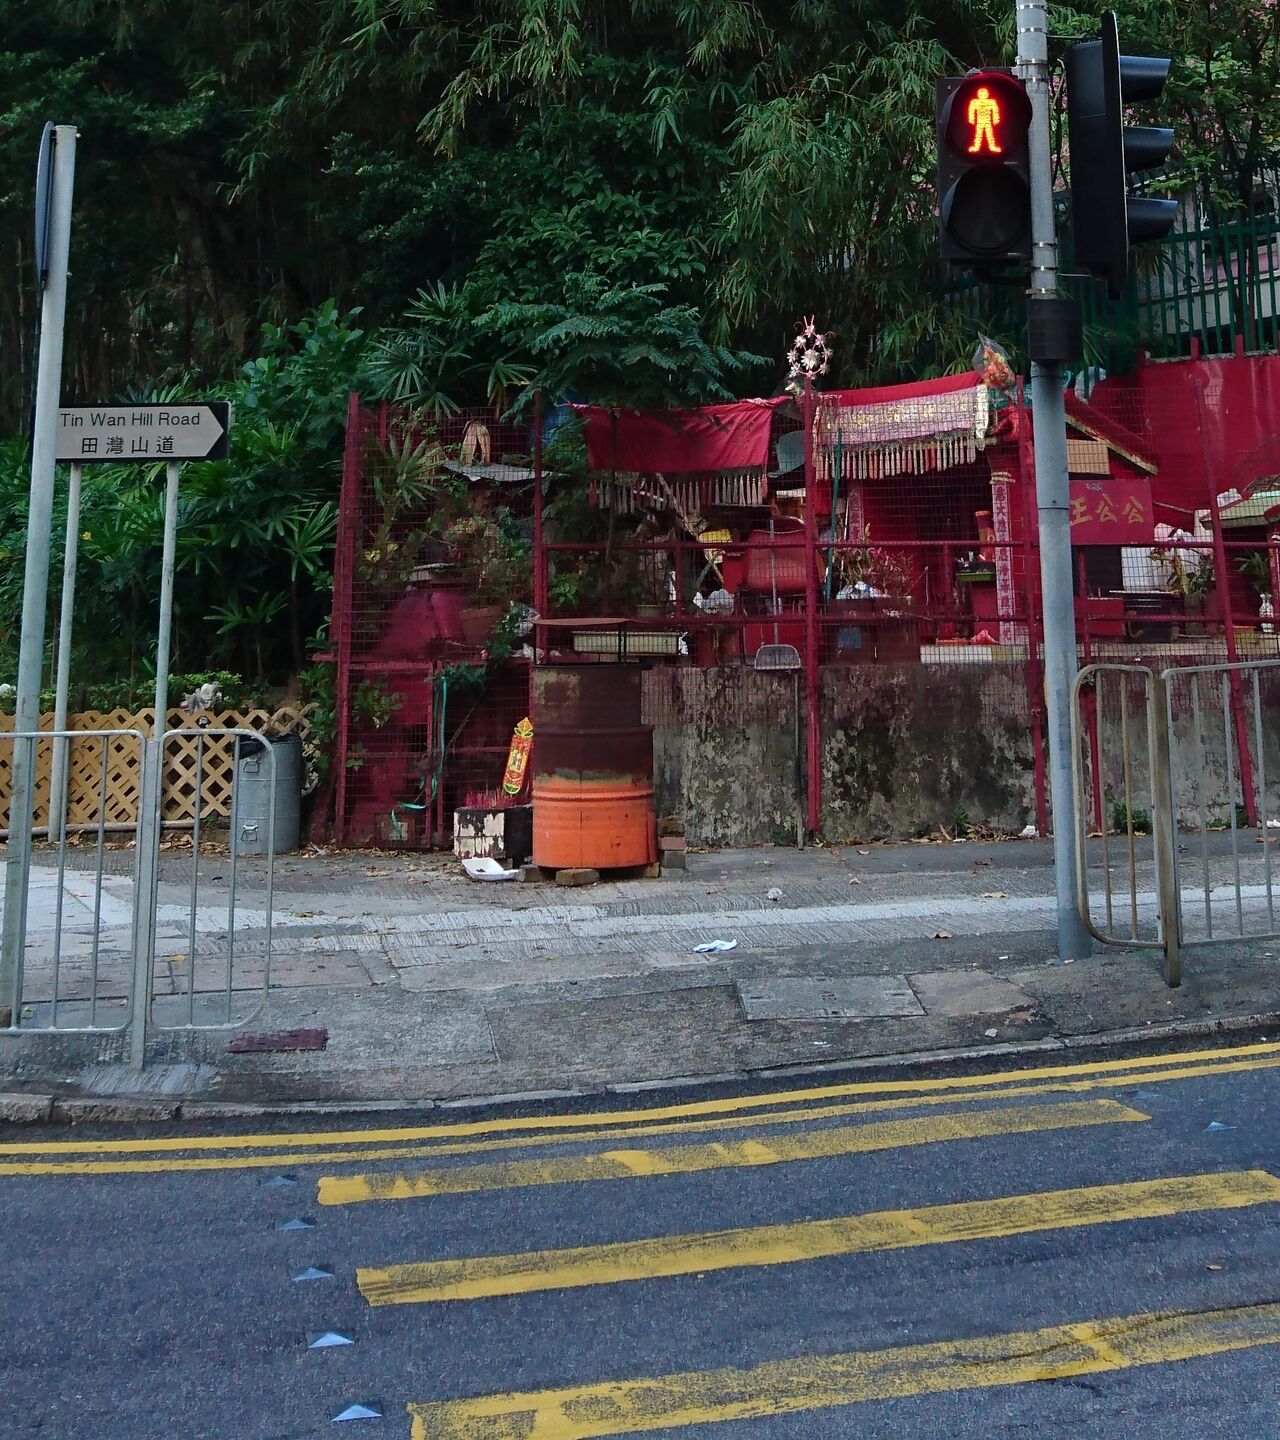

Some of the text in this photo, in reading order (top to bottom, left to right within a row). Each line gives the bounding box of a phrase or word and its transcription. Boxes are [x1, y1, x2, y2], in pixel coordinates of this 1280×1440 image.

[60, 412, 200, 427] Tin Wan Hill Road
[81, 435, 174, 455] 田灣山道
